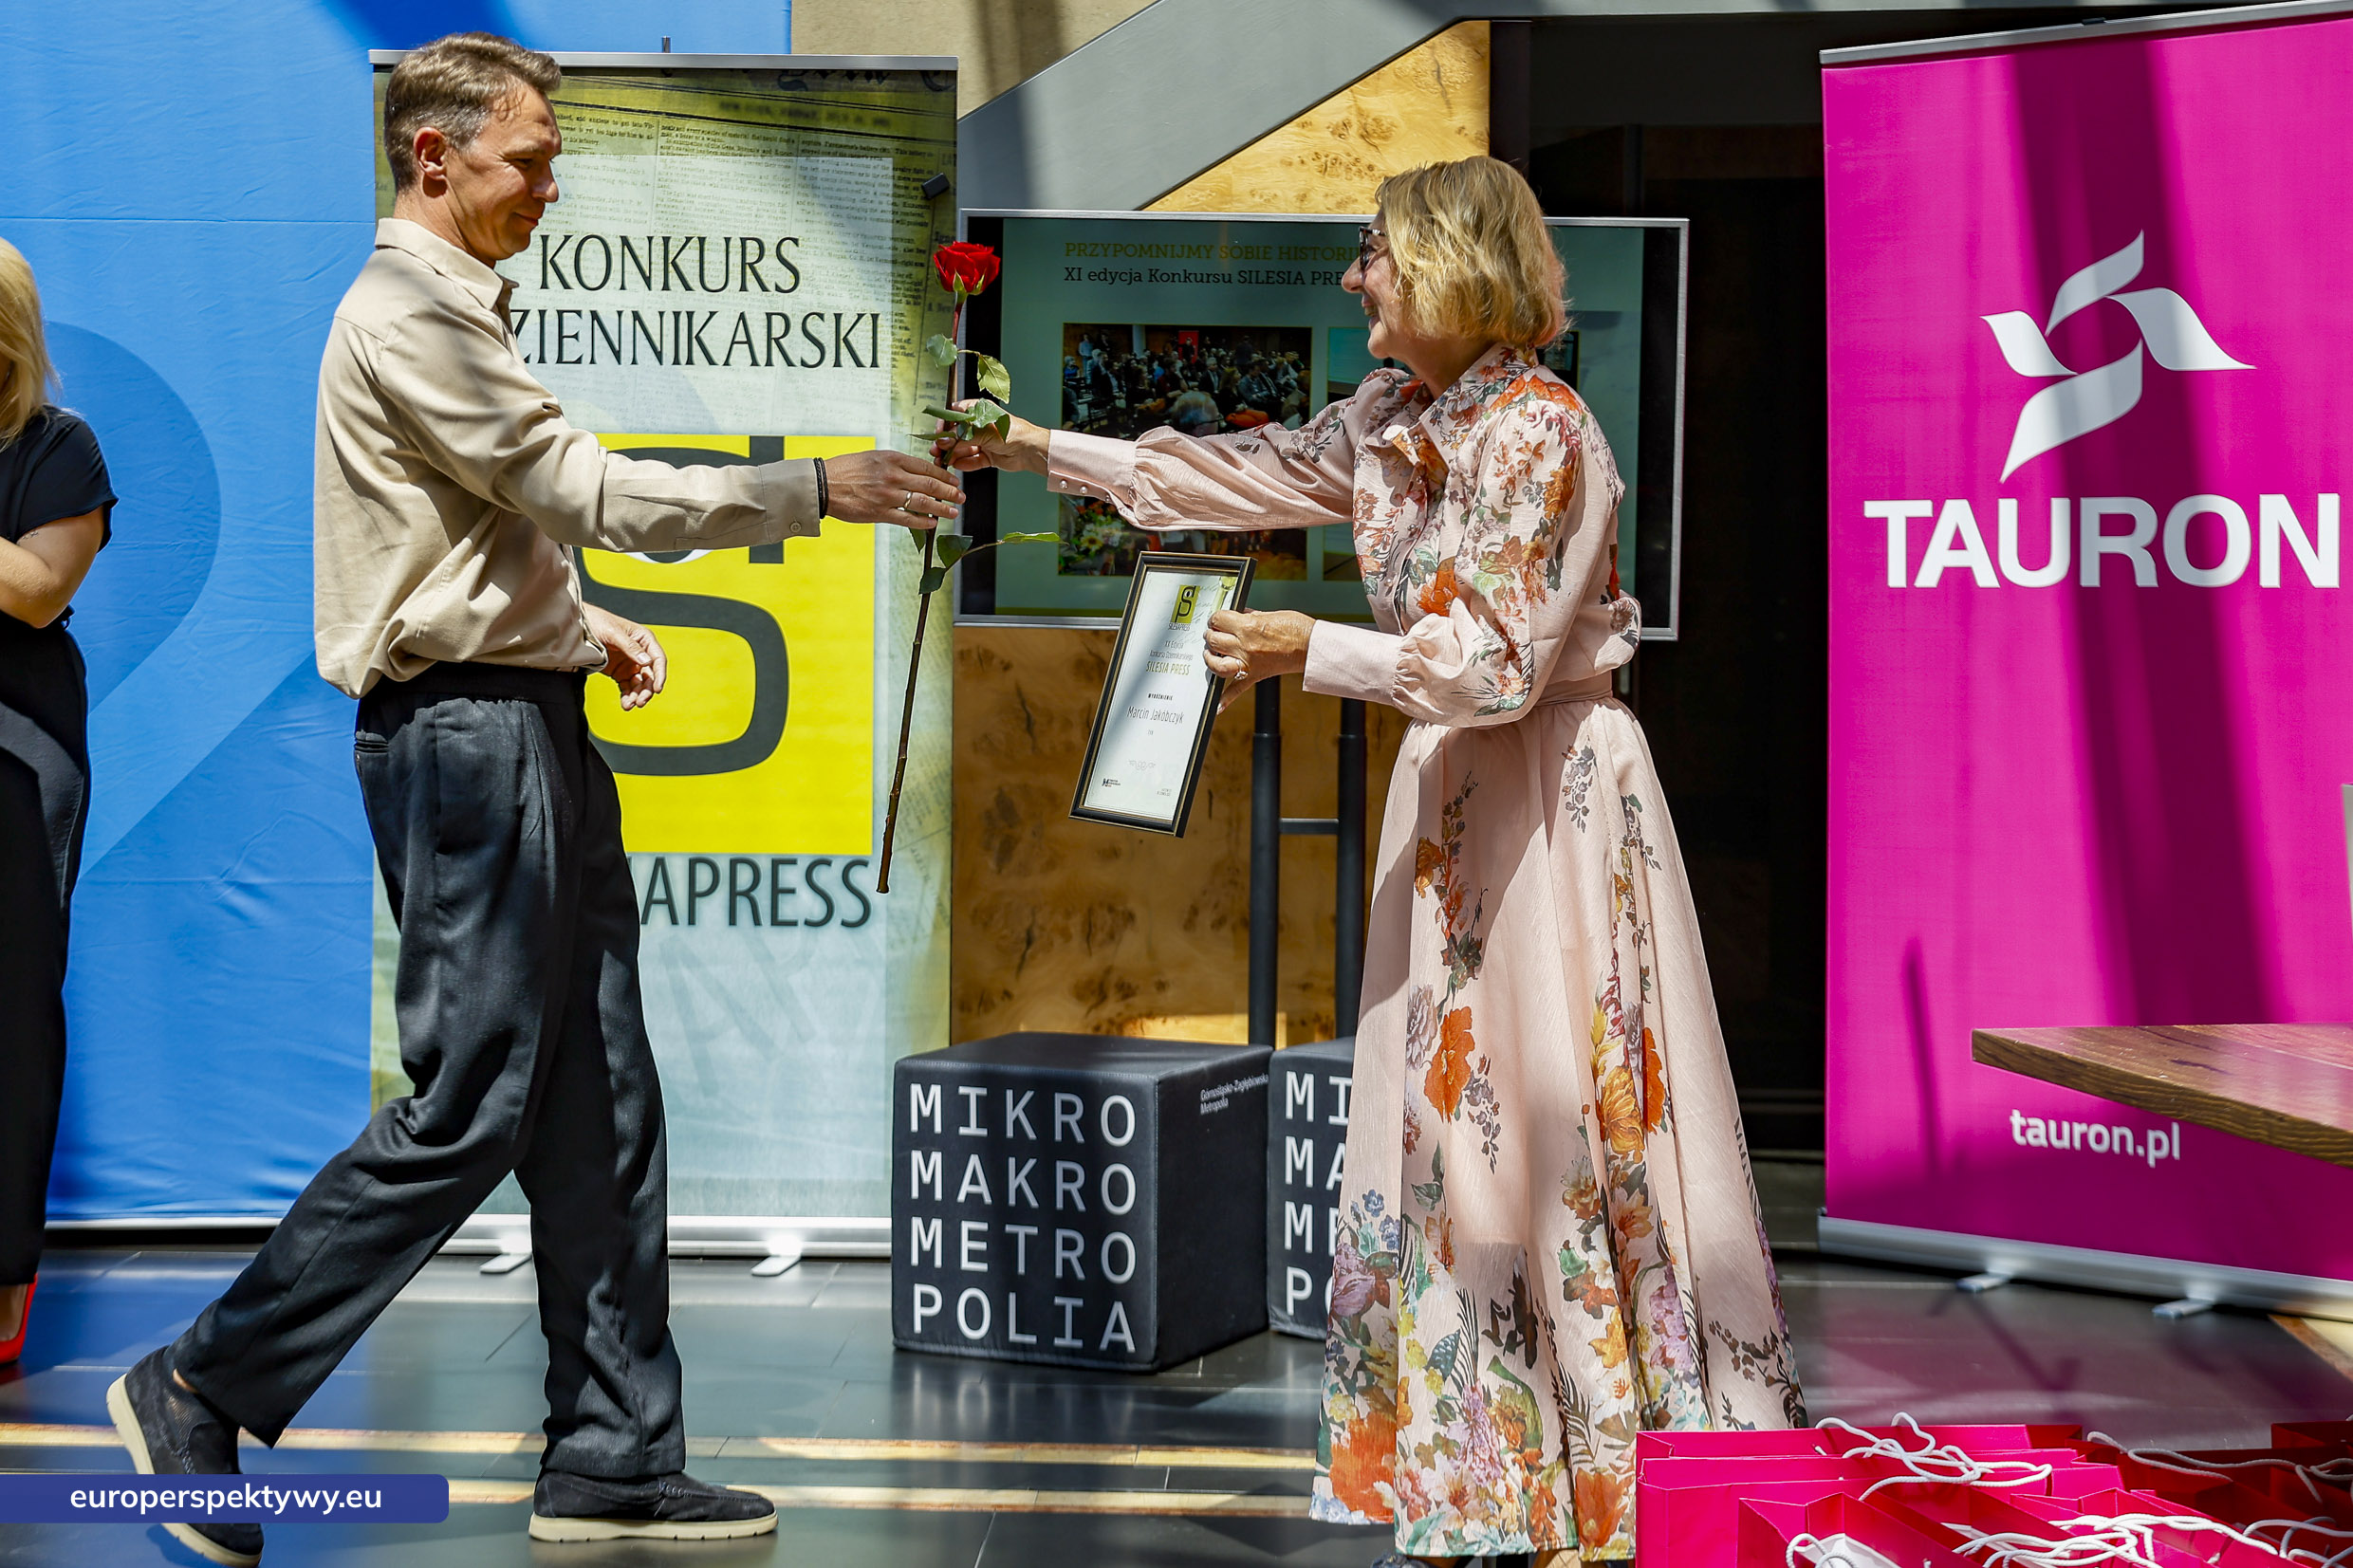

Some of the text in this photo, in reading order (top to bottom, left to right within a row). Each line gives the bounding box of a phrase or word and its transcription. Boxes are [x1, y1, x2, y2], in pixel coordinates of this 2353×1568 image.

[540, 233, 801, 293] KONKURS
[1065, 243, 1360, 262] PRZYPOMNIJMY SOBIE HISTORI
[1065, 267, 1344, 286] XI edycja Konkursu SILESIA PRE
[510, 308, 880, 368] ZIENNIKARSKI
[1863, 492, 2341, 589] TAURON
[1145, 660, 1191, 675] SILESIA PRESS
[1126, 705, 1150, 720] Marcin
[634, 858, 872, 929] APRESS
[910, 1082, 1137, 1147] MIKRO
[2010, 1109, 2180, 1169] tauron.pl
[910, 1150, 1137, 1216] MAKRO
[910, 1216, 1137, 1284] METRO
[913, 1283, 1137, 1354] POLIA
